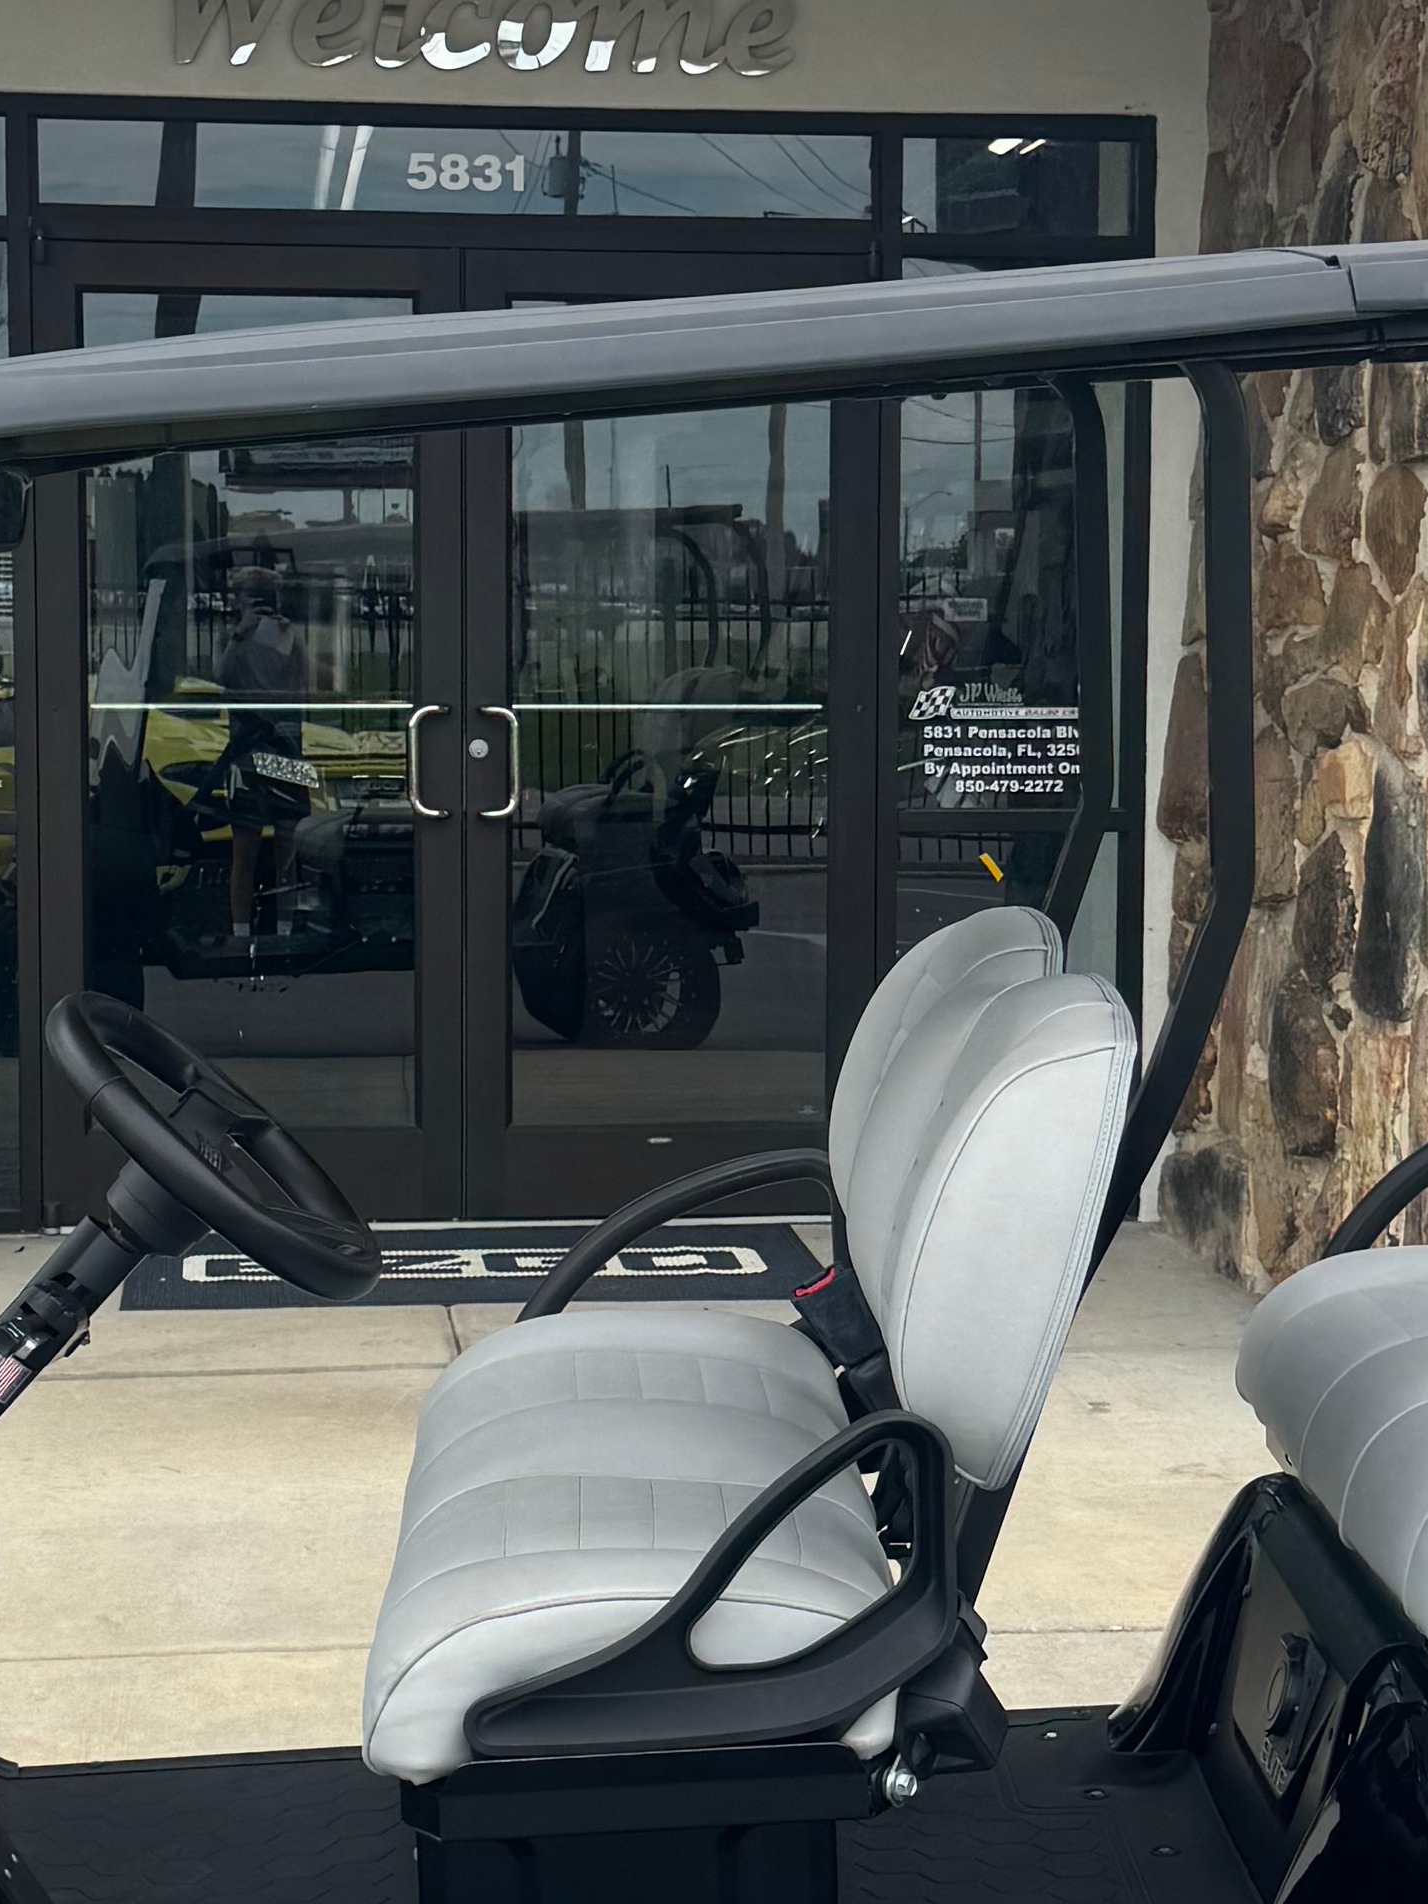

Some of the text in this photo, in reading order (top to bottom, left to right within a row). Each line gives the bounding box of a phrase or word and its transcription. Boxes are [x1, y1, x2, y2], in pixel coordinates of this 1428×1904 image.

[406, 153, 526, 193] 5831
[923, 726, 961, 739] 5831
[968, 725, 1051, 739] Pensacola
[923, 744, 1011, 759] Pensacola,
[1017, 744, 1042, 759] FL,
[924, 762, 944, 777] By
[950, 762, 1053, 777] Appointment
[955, 780, 1064, 793] 850-479-2272
